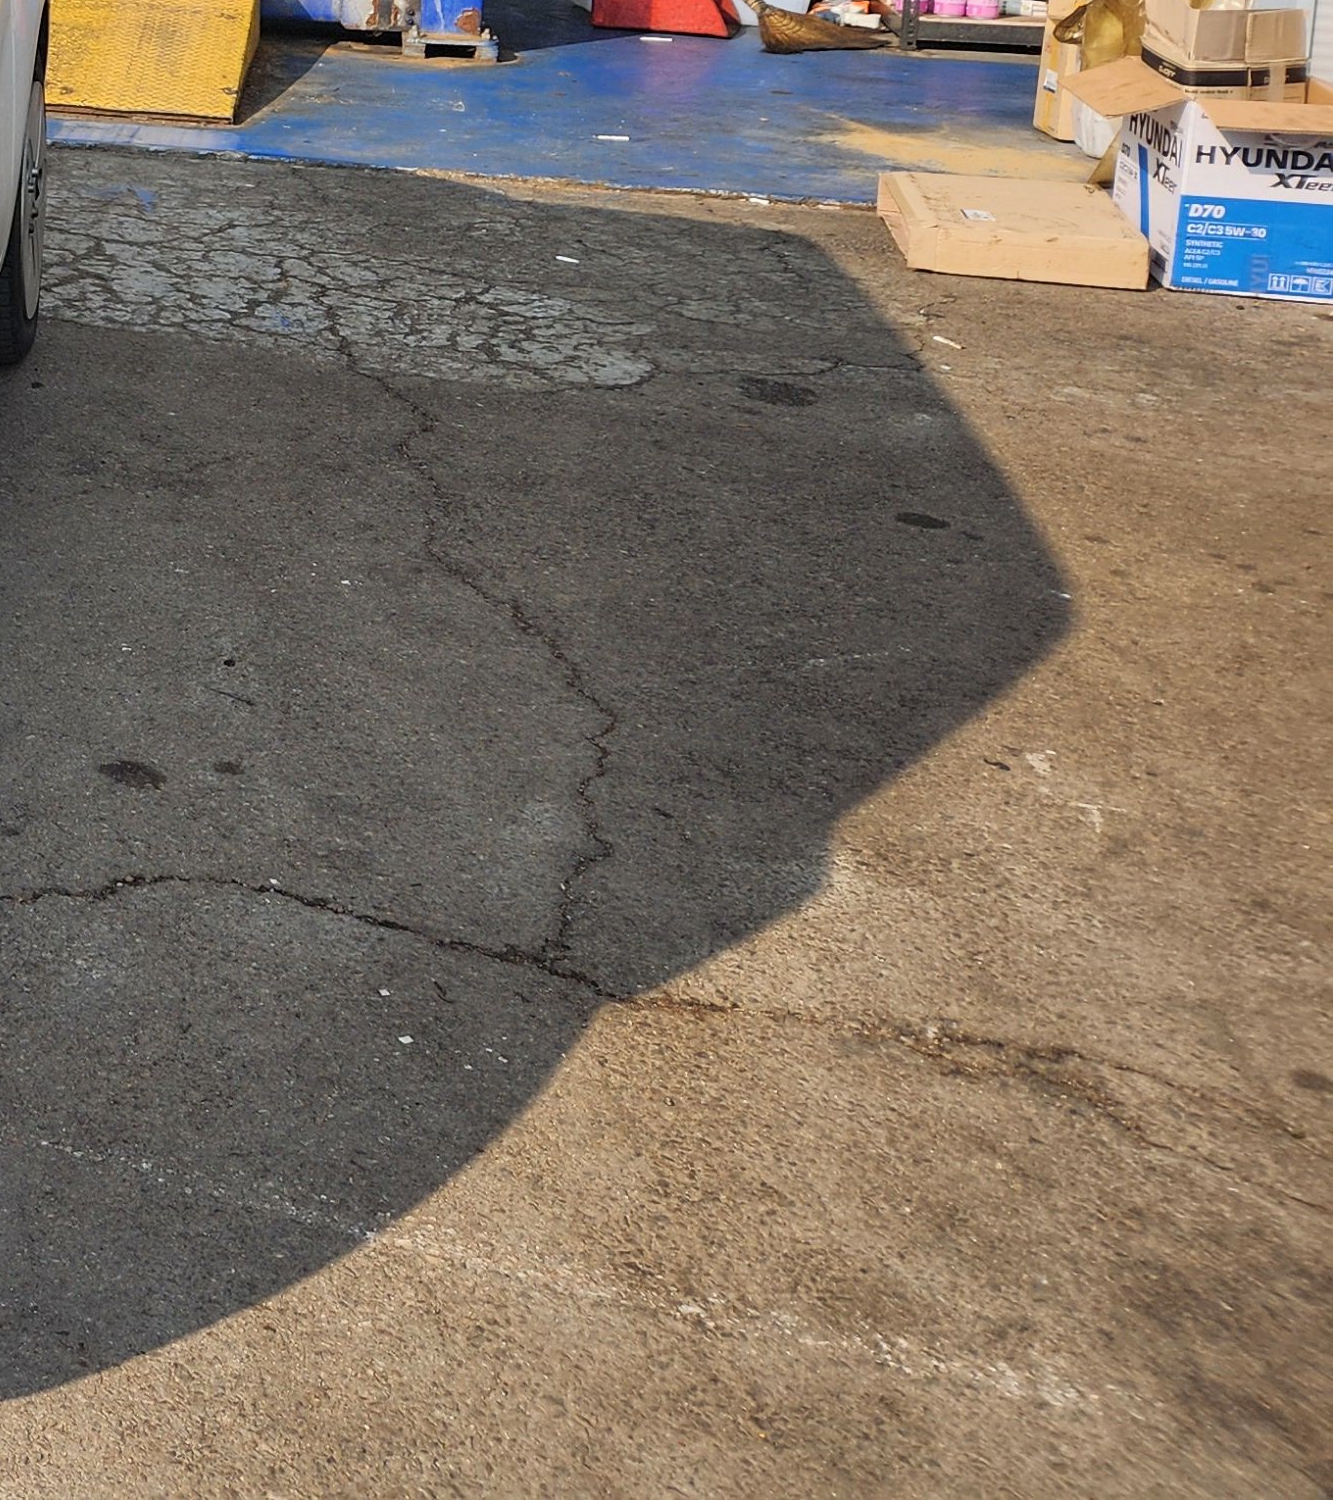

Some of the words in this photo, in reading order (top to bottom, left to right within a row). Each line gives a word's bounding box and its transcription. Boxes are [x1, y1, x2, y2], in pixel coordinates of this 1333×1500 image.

[1129, 113, 1183, 168] HYUNDAI
[1269, 172, 1333, 191] XTee
[1189, 204, 1226, 219] D70
